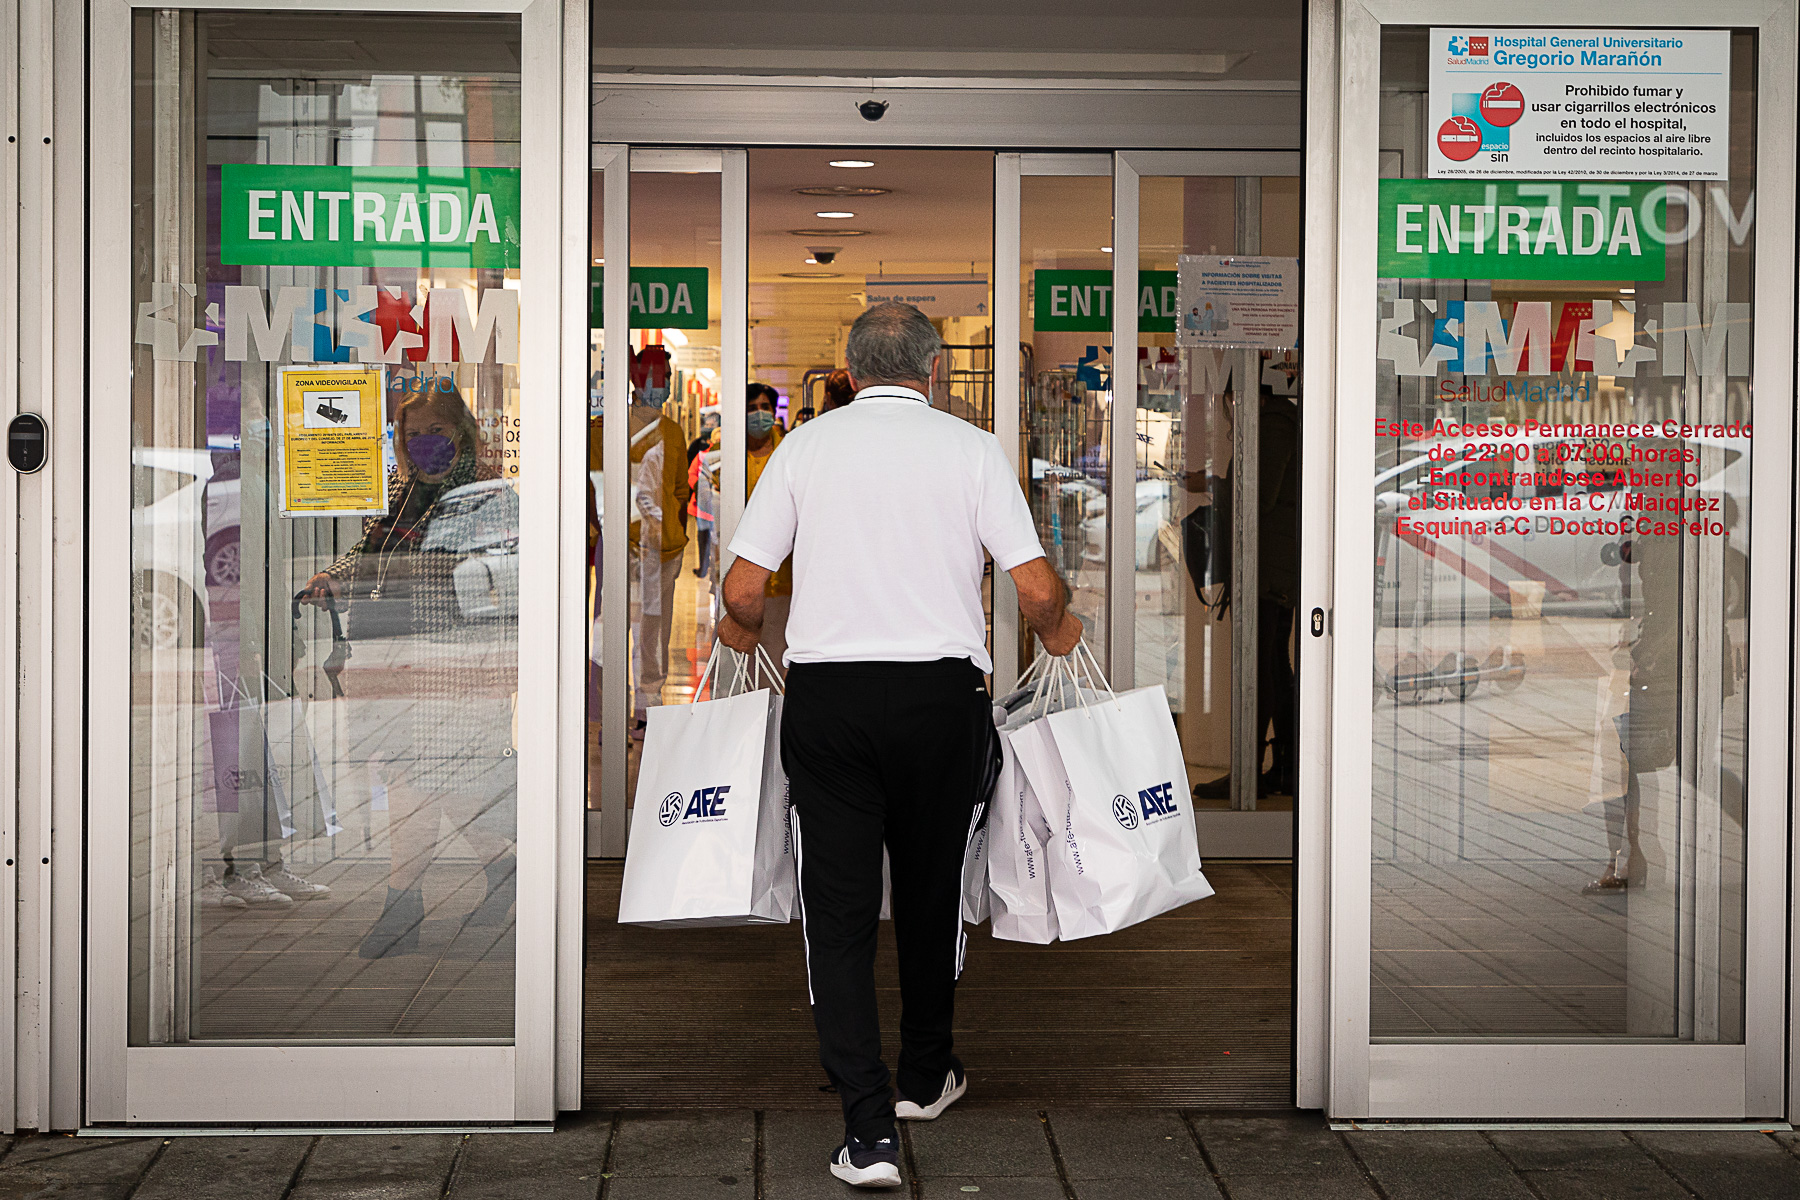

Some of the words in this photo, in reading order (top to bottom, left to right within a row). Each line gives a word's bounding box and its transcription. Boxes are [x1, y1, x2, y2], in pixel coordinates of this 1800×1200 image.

[1494, 36, 1547, 49] Hospital
[1550, 36, 1600, 48] General
[1603, 37, 1683, 49] Universitario
[1447, 57, 1489, 66] SaludMadrid
[1493, 50, 1575, 69] Gregorio
[1580, 51, 1662, 67] Marañón
[1565, 84, 1629, 97] Prohibido
[1633, 86, 1672, 97] fumar
[1675, 88, 1684, 99] y
[1531, 103, 1561, 112] usar
[1564, 101, 1631, 115] cigarrillos
[1634, 102, 1717, 113] electrónicos
[1560, 120, 1577, 129] en
[1581, 118, 1611, 129] todo
[1614, 118, 1627, 129] el
[1630, 118, 1687, 132] hospital,
[1481, 143, 1509, 151] espacio
[1535, 133, 1583, 142] incluidos
[1585, 133, 1601, 142] los
[1604, 134, 1651, 144] espacios
[1653, 134, 1663, 143] al
[1666, 134, 1686, 143] aire
[1688, 134, 1712, 143] libre
[1490, 150, 1509, 163] sin
[1543, 146, 1578, 155] dentro
[1581, 146, 1597, 155] del
[1600, 147, 1636, 155] recinto
[1639, 147, 1703, 157] hospitalario.
[248, 189, 501, 243] ENTRADA
[1396, 203, 1642, 256] ENTRADA
[1375, 418, 1424, 437] Este
[1431, 419, 1518, 437] Acceso
[1524, 418, 1655, 438] Permanece
[1661, 419, 1753, 438] Cerrado
[1427, 443, 1457, 462] de
[1463, 442, 1530, 463] 22:30
[1536, 447, 1550, 462] a
[1556, 442, 1625, 463] 07:00
[1630, 443, 1701, 466] horas,
[1429, 467, 1606, 487] Encontrandose
[1611, 468, 1698, 488] Abierto
[1407, 491, 1427, 511] el
[1433, 491, 1523, 511] Situado
[1529, 496, 1557, 511] en
[1562, 492, 1582, 511] la
[1624, 492, 1720, 516] Maiquez
[1394, 516, 1487, 539] Esquina
[1494, 520, 1507, 536] a
[1513, 516, 1530, 536] C
[1550, 516, 1629, 536] Doctor
[683, 786, 731, 820] AFE
[1138, 781, 1178, 821] AFE
